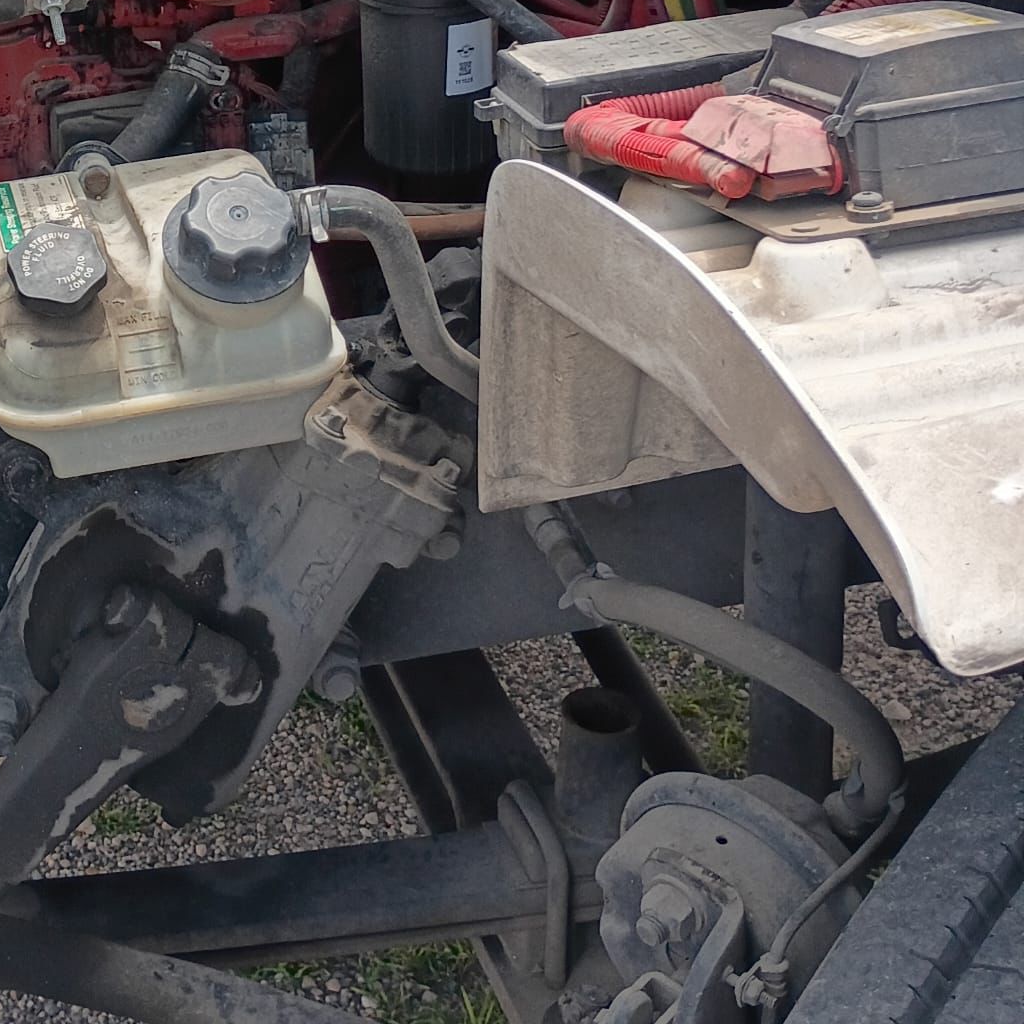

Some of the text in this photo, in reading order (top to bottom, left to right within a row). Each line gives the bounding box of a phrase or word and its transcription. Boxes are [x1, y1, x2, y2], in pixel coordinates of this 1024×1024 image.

[21, 232, 70, 277] POWER STEERING
[31, 241, 54, 262] FLUID
[56, 255, 86, 285] OVERFILL
[68, 267, 94, 291] DO NOT
